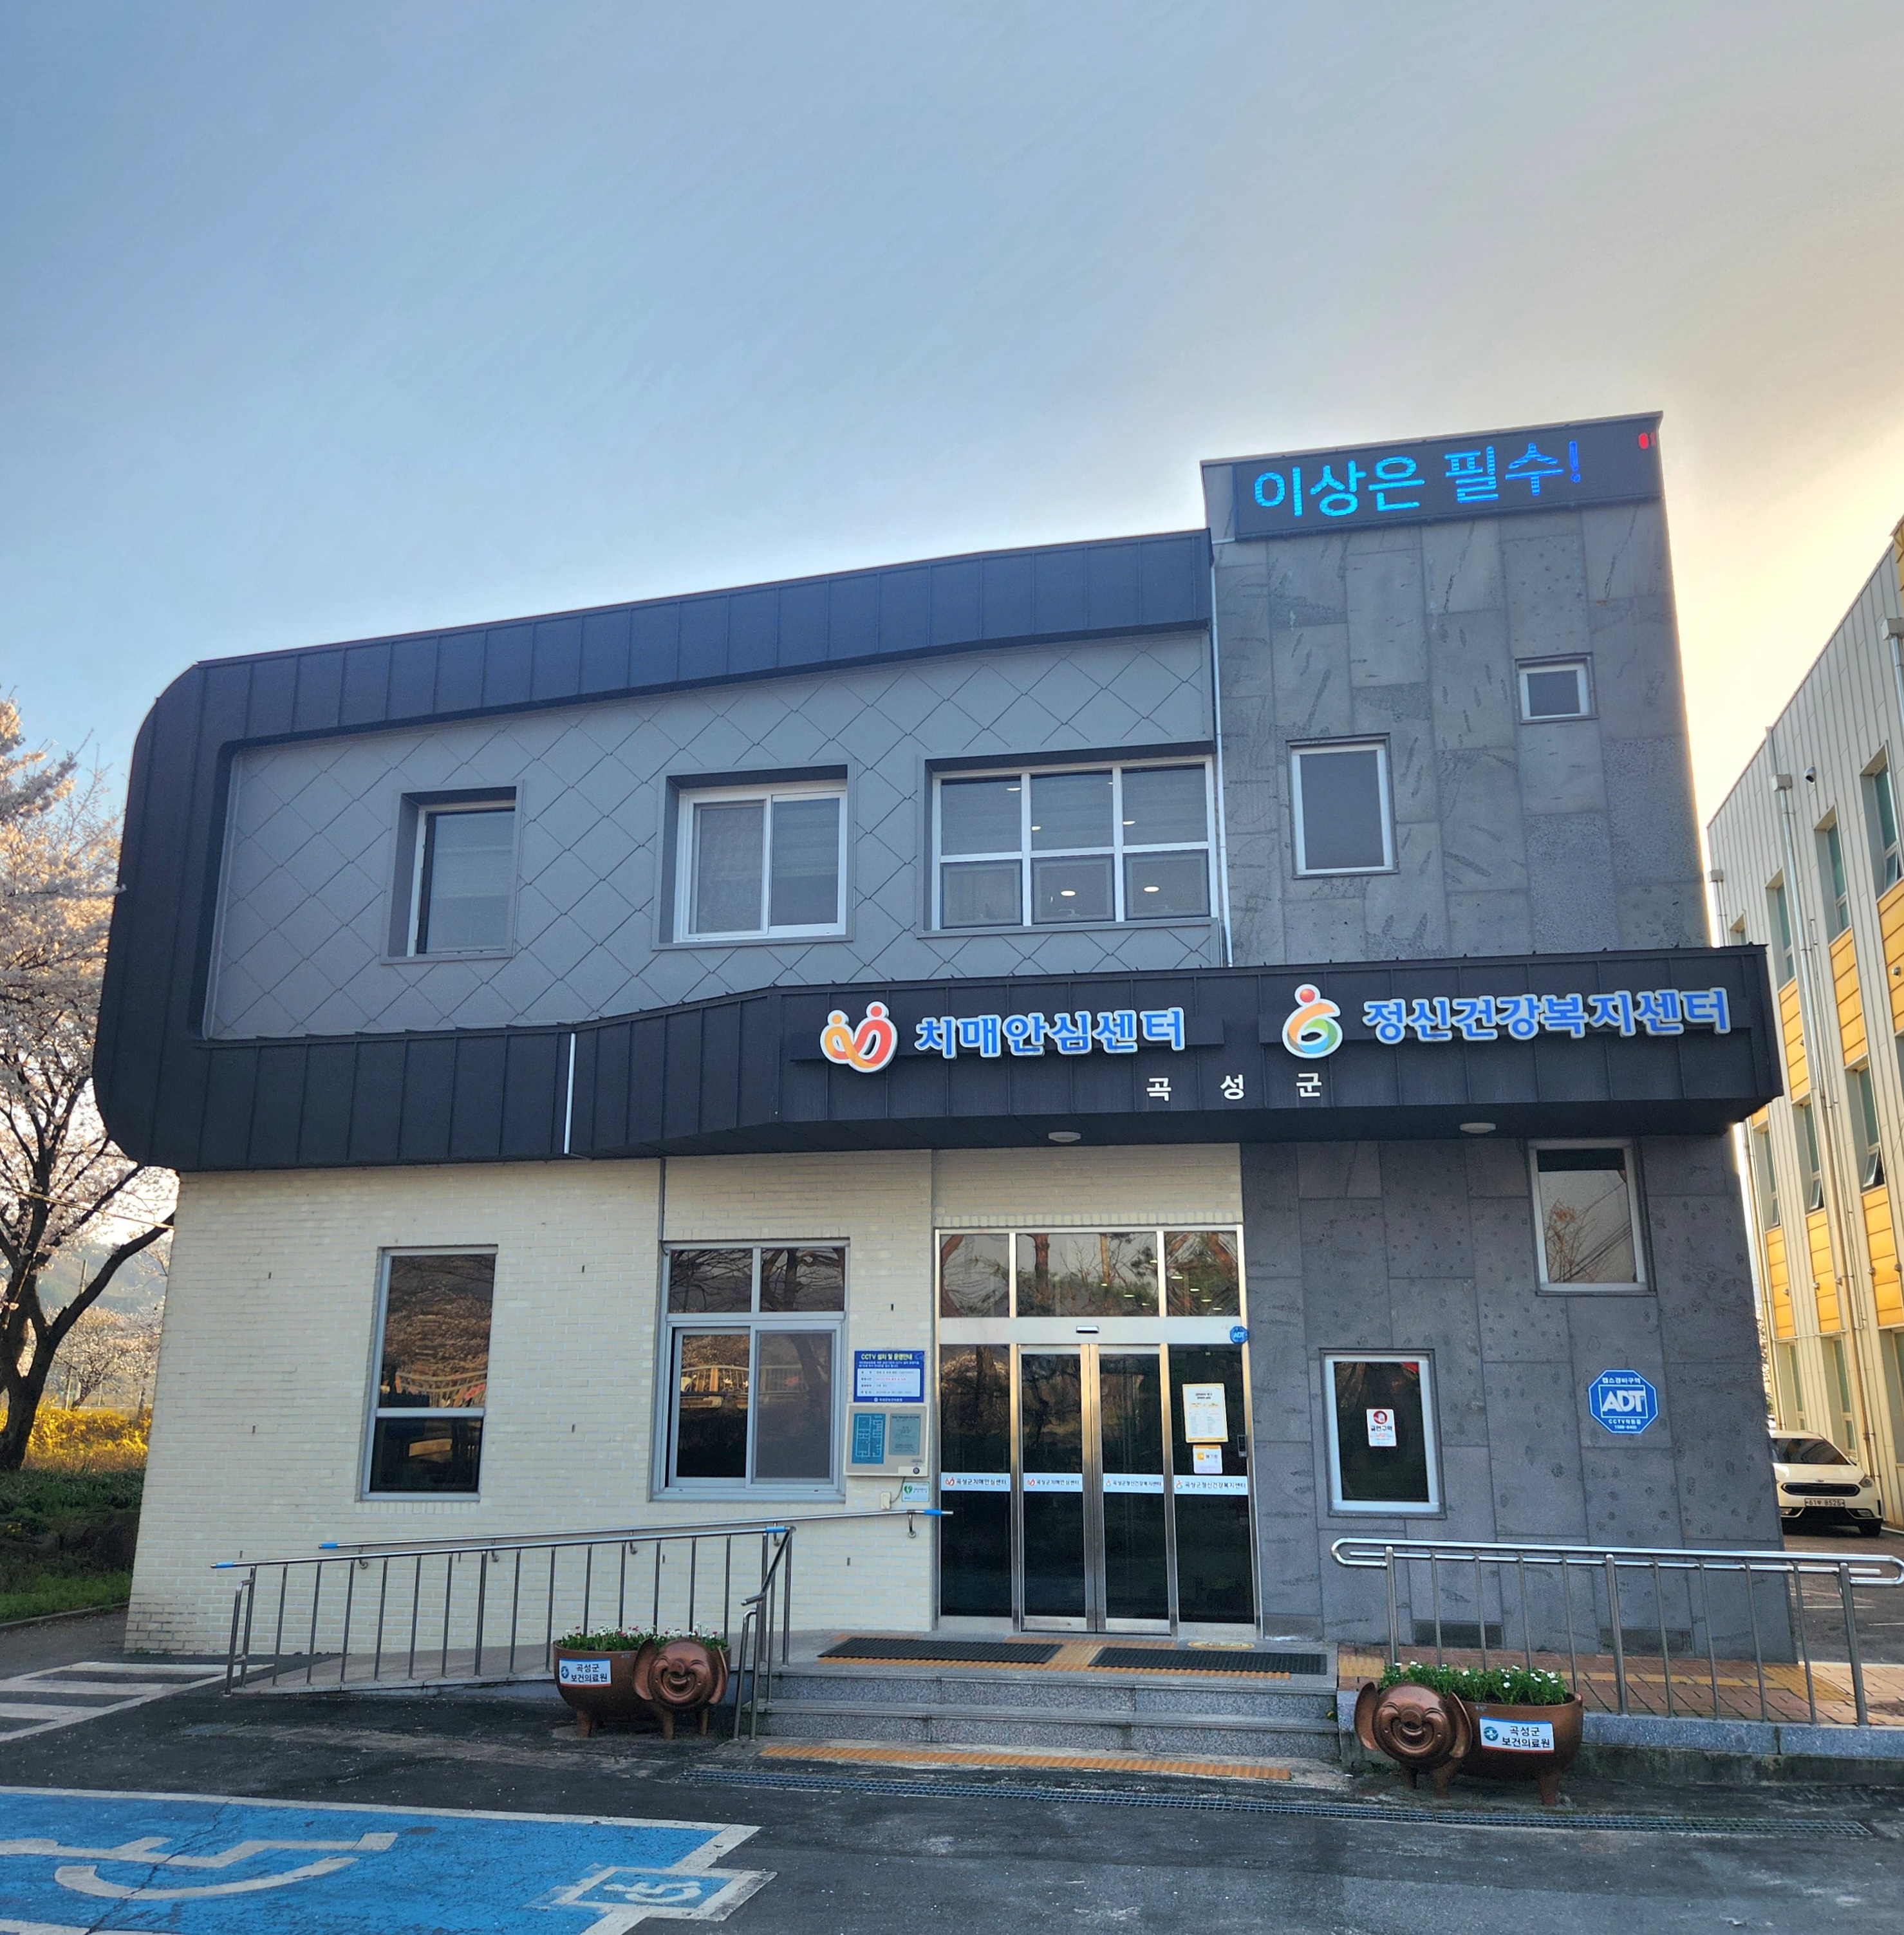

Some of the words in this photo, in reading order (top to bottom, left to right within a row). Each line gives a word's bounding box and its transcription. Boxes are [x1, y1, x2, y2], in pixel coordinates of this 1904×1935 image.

[1254, 456, 1425, 517] 이상은
[1444, 441, 1582, 504] 필수!
[1362, 987, 1731, 1044] 정신건강복지센터
[914, 1007, 1186, 1060] 치매안심센터
[1146, 1076, 1172, 1102] 곡
[1220, 1074, 1245, 1101] 성
[1296, 1072, 1322, 1098] 군
[1601, 1390, 1645, 1412] ADT
[570, 1673, 608, 1683] 보건의료원
[575, 1663, 600, 1673] 곡성군
[1509, 1725, 1540, 1737] 곡성군
[1502, 1736, 1550, 1749] 보건의료원
